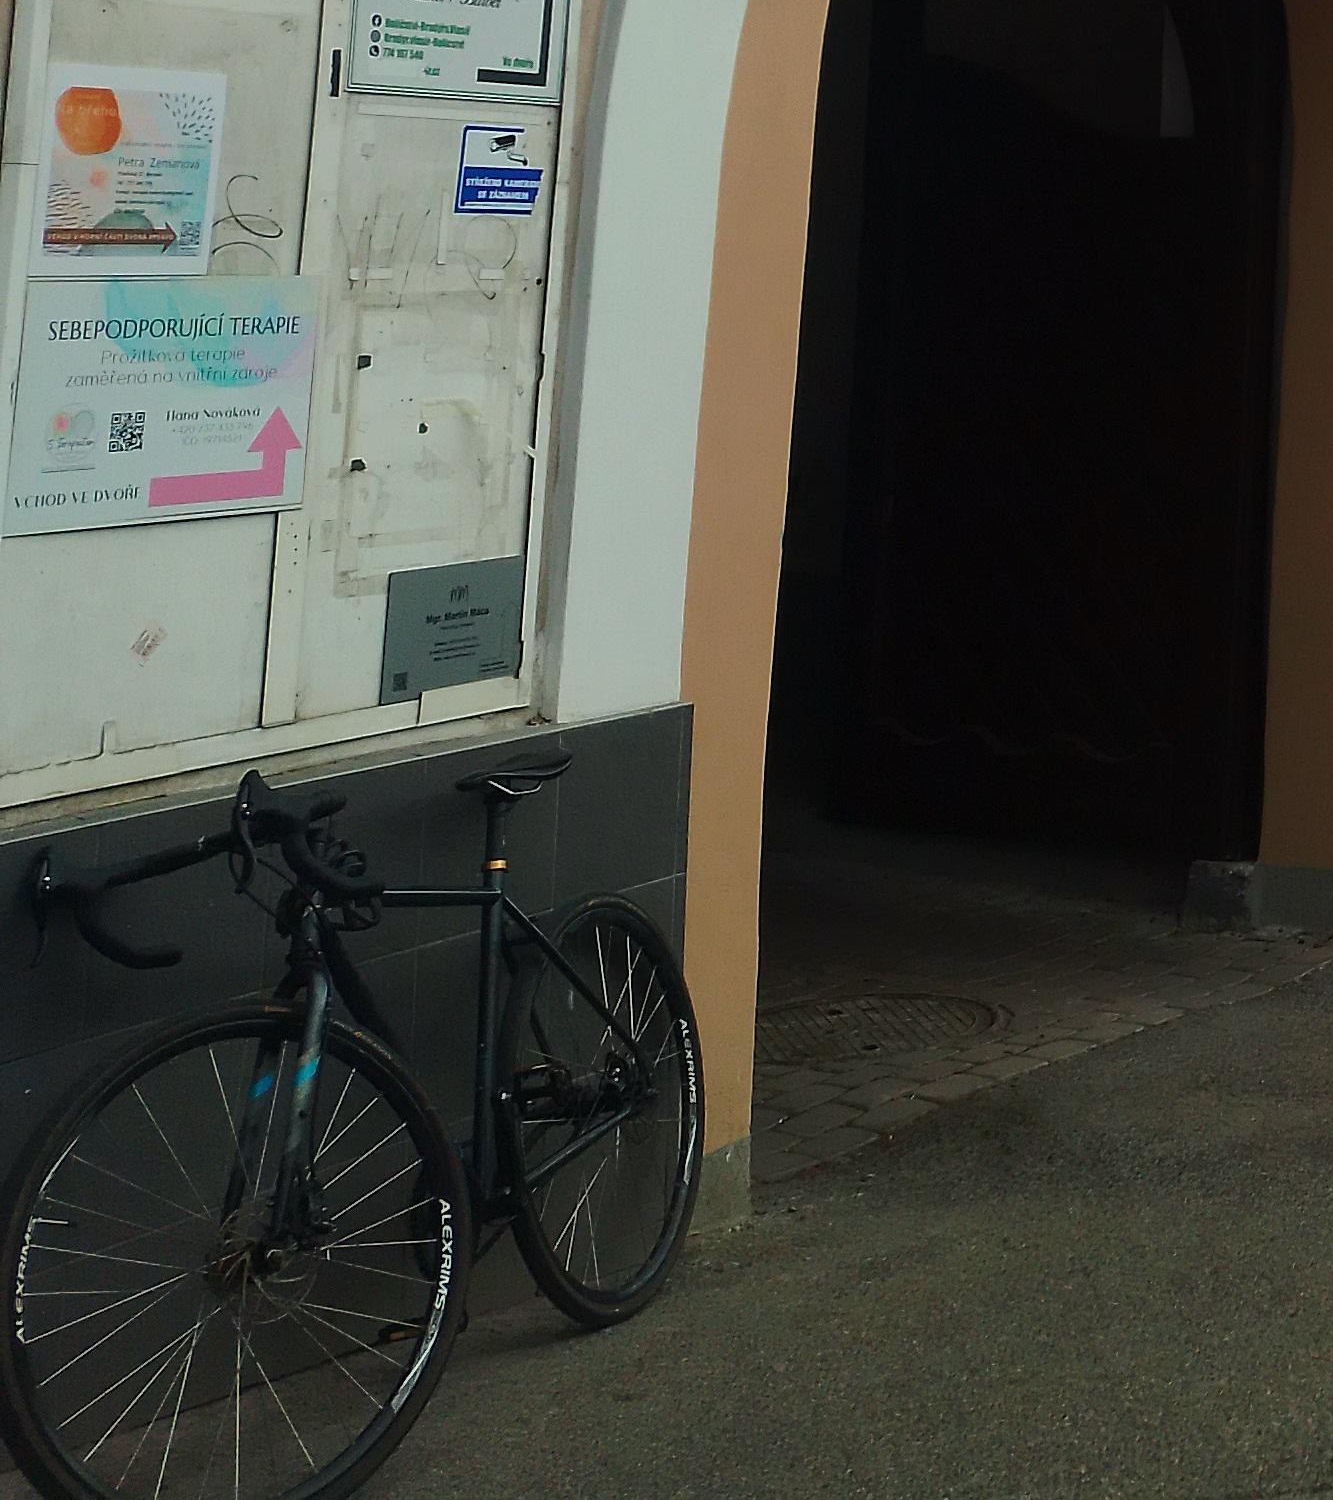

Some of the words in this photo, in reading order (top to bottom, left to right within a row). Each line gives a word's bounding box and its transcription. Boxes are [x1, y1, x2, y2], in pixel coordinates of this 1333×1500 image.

[118, 156, 145, 168] Petra
[48, 313, 225, 341] SEBEPODPORUJÍCÍ
[229, 315, 300, 336] TERAPIE
[101, 348, 185, 365] Prožitková
[190, 348, 246, 364] terapie
[65, 369, 147, 388] zaměřená
[153, 371, 174, 383] na
[177, 366, 227, 382] vnitřní
[231, 365, 279, 382] zdroje
[166, 410, 199, 422] Hana
[14, 493, 67, 509] VCHOD
[72, 491, 90, 504] VE
[93, 484, 142, 503] DVOŘE
[679, 1018, 697, 1104] ALEXRIMS
[431, 1198, 455, 1311] ALEXRIMS
